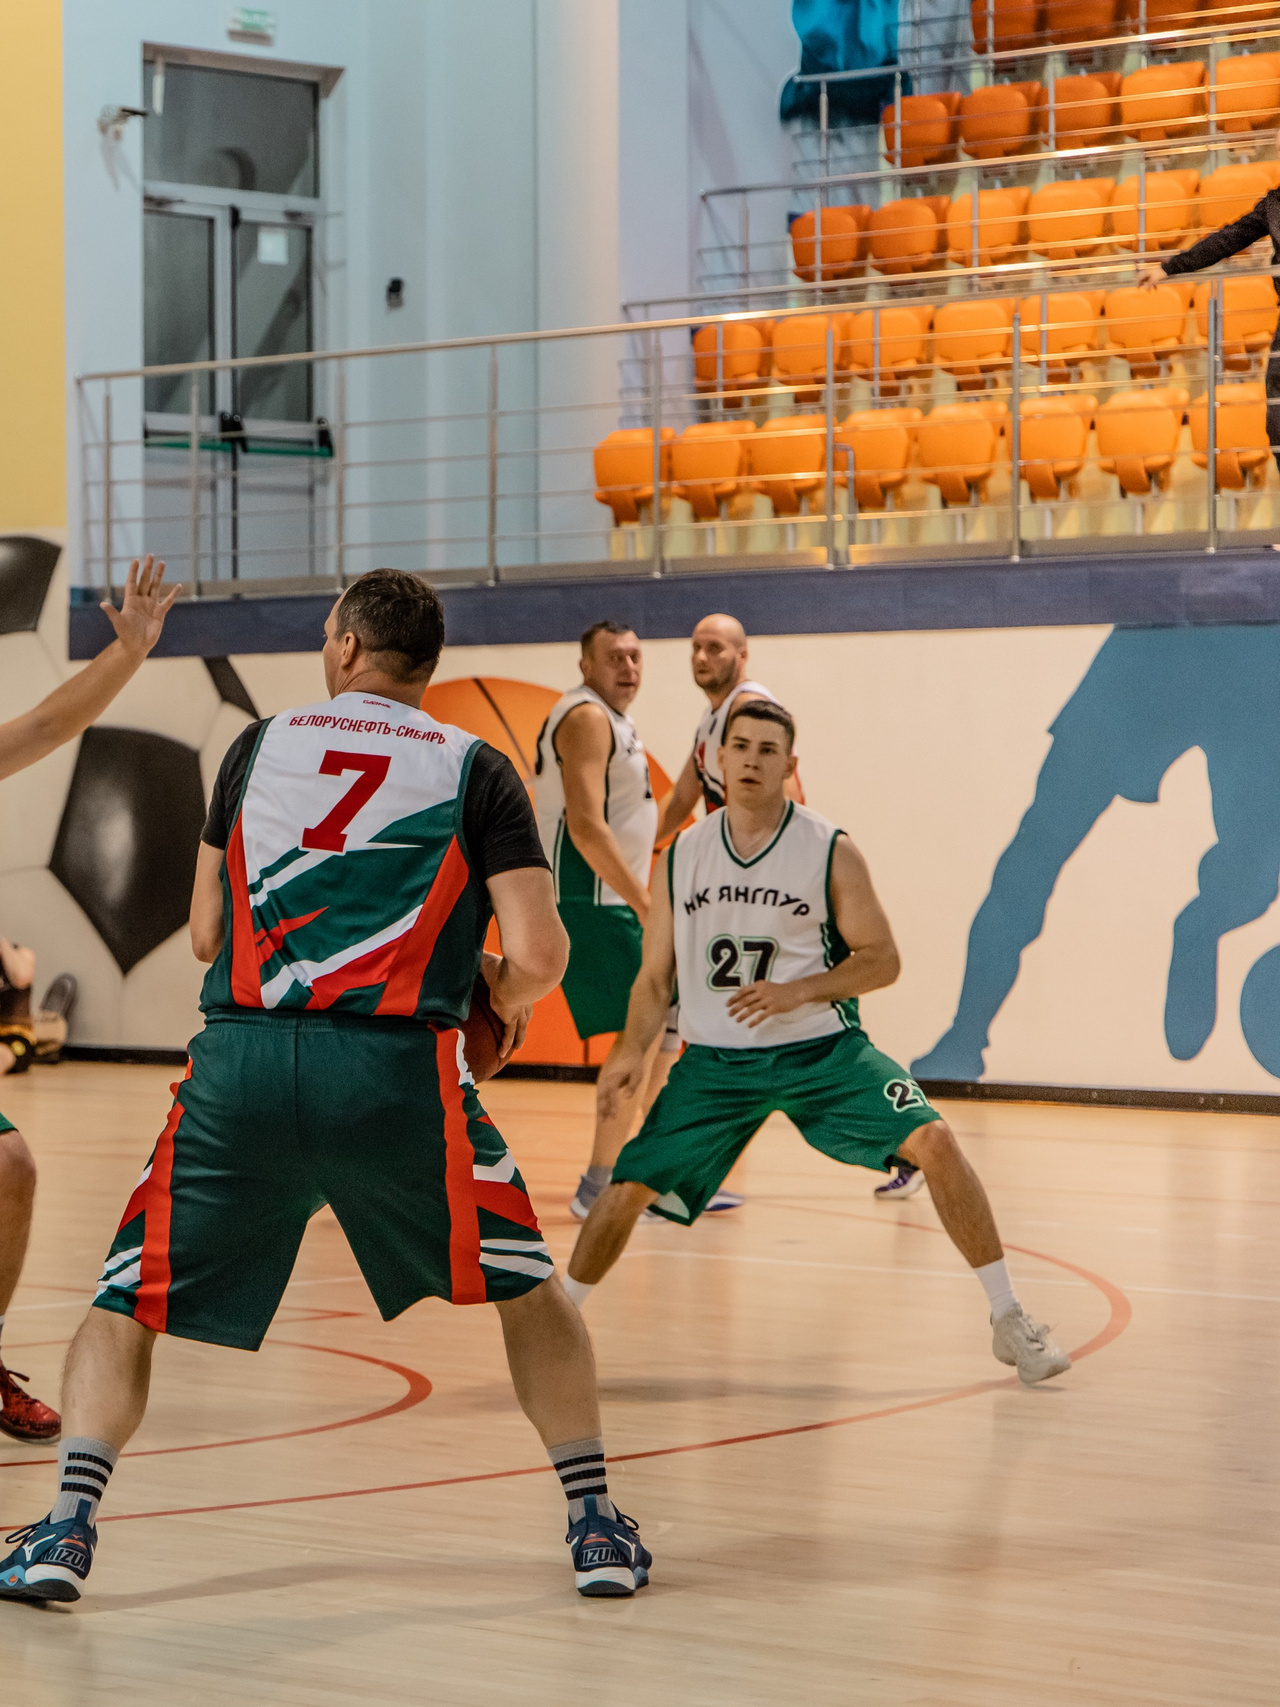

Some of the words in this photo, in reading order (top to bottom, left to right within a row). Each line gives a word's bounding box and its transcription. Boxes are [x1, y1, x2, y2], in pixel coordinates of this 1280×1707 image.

[289, 714, 446, 745] БЕЛОРУСНЕФТЬ-СИБИРЬ
[301, 749, 392, 853] 7
[683, 887, 711, 916] НК
[718, 885, 811, 916] ЯНГПУР
[707, 936, 778, 991] 27
